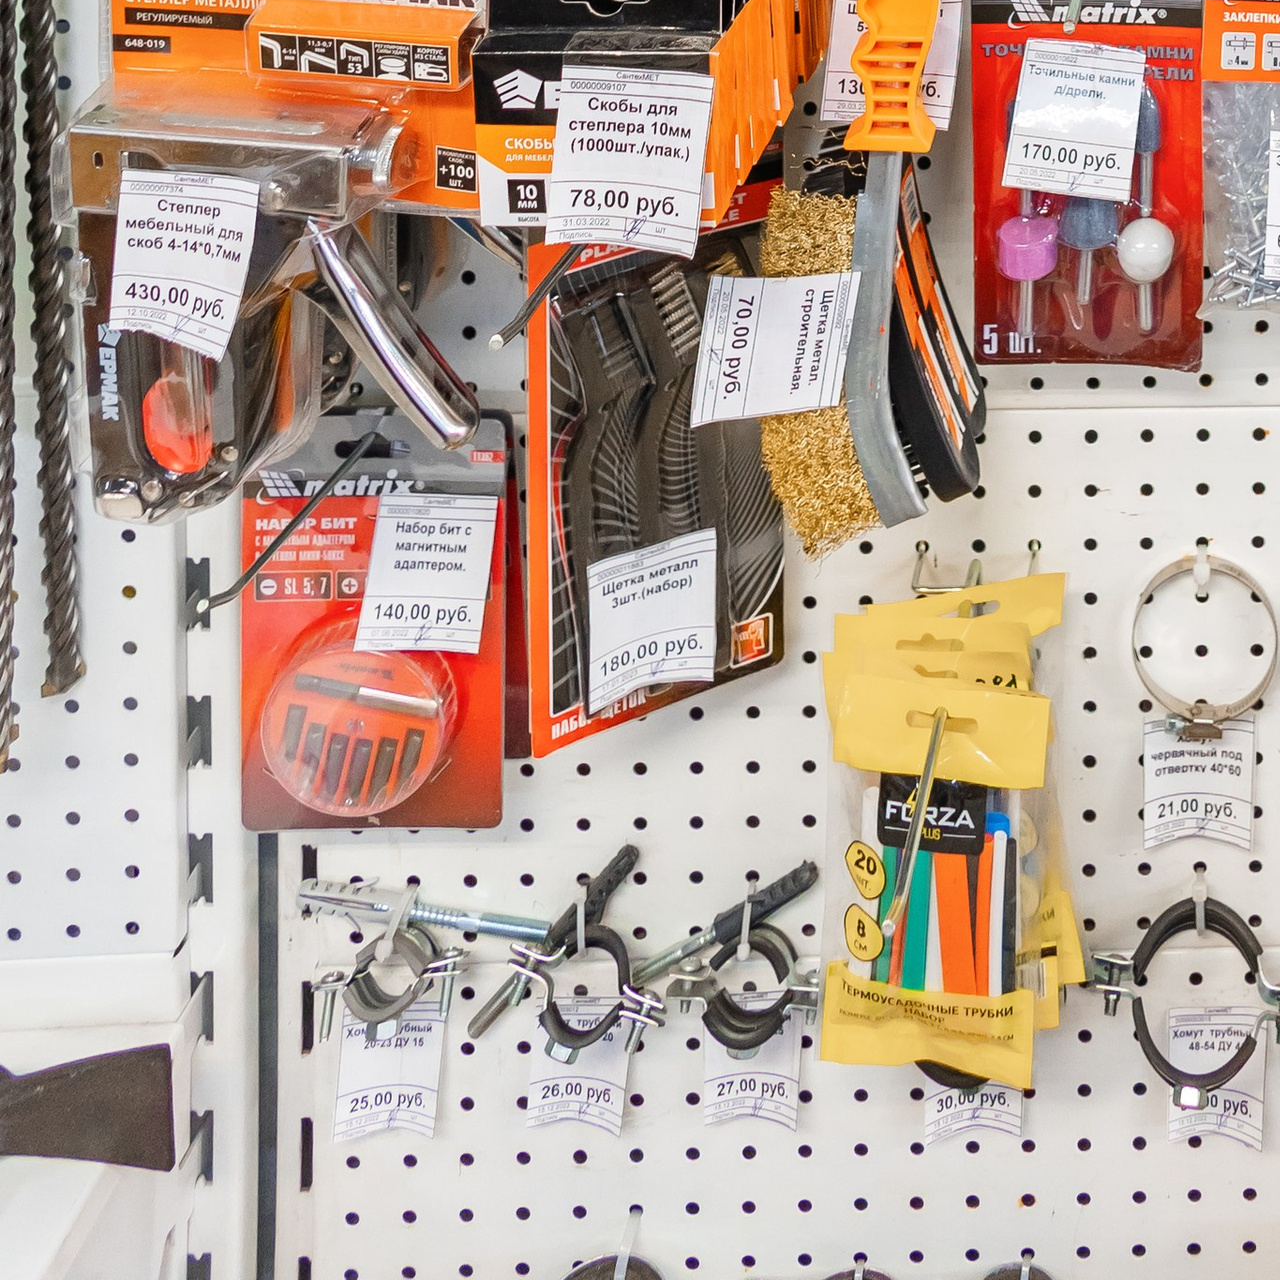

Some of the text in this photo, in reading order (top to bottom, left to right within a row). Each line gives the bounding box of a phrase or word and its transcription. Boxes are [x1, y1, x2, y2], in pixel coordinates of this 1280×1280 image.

[136, 12, 213, 26] РЕГУЛИРУЕМЫЙ
[569, 117, 692, 140] степлера 10мм
[1022, 142, 1121, 173] 170,00 руб.
[569, 189, 680, 219] 78,00 руб.
[125, 281, 225, 320] 430,00 руб.
[815, 289, 834, 335] Щетка
[723, 295, 755, 401] 70,00 руб.
[395, 539, 467, 554] магнитным
[394, 556, 466, 573] адаптером.
[374, 604, 472, 624] 140,00 руб.
[1157, 799, 1237, 820] 21,00 руб.
[349, 1090, 427, 1113] 25,00 руб.
[716, 1079, 789, 1101] 27,00 руб.
